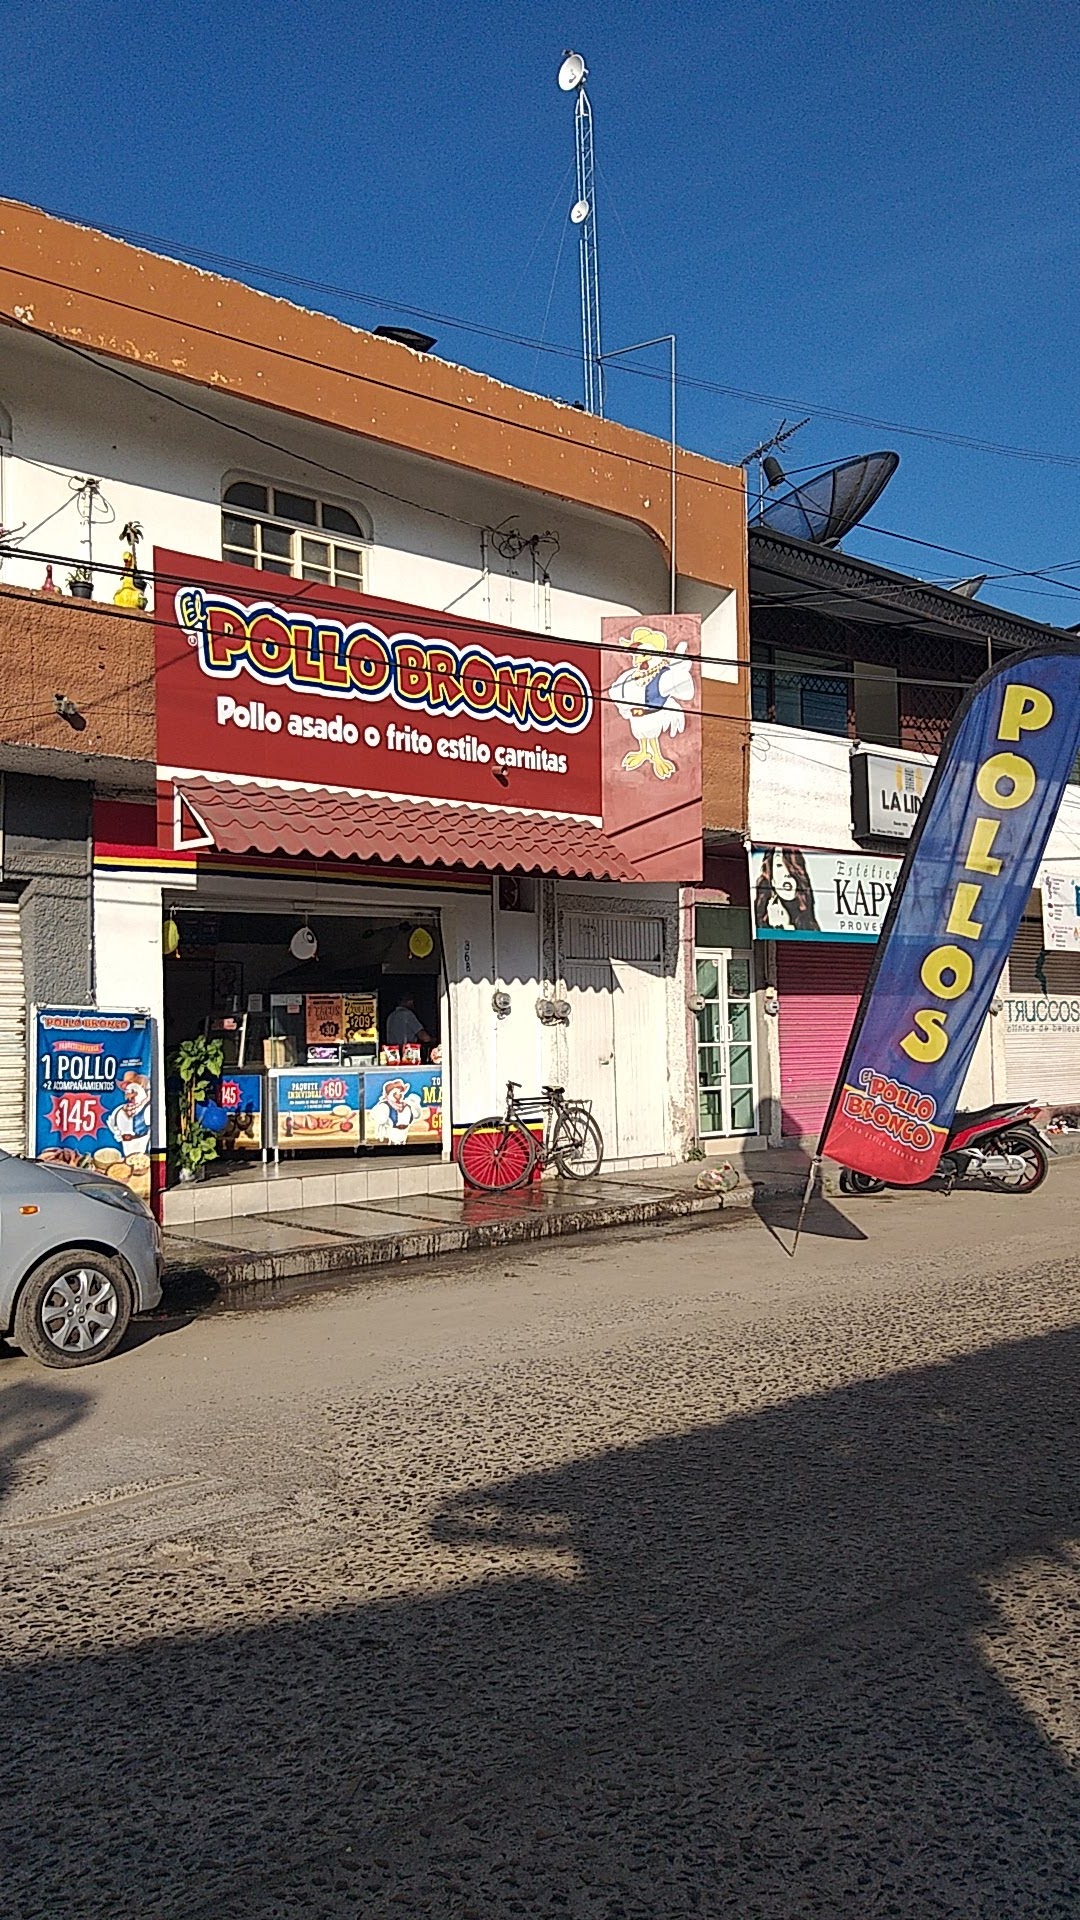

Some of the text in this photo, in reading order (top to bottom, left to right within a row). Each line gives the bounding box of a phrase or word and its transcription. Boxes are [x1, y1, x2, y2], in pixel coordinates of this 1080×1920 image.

[181, 592, 207, 627] El
[204, 603, 587, 725] POLLO BRONCO
[216, 695, 568, 774] Pollo asado o frito estilo carnitas
[881, 789, 901, 812] LA
[899, 683, 1054, 1063] POLLOS
[41, 1054, 117, 1080] 1 POLLO
[323, 1081, 342, 1098] $60
[870, 1076, 934, 1120] POLLO
[55, 1098, 98, 1132] $145
[846, 1094, 931, 1148] BRONCO
